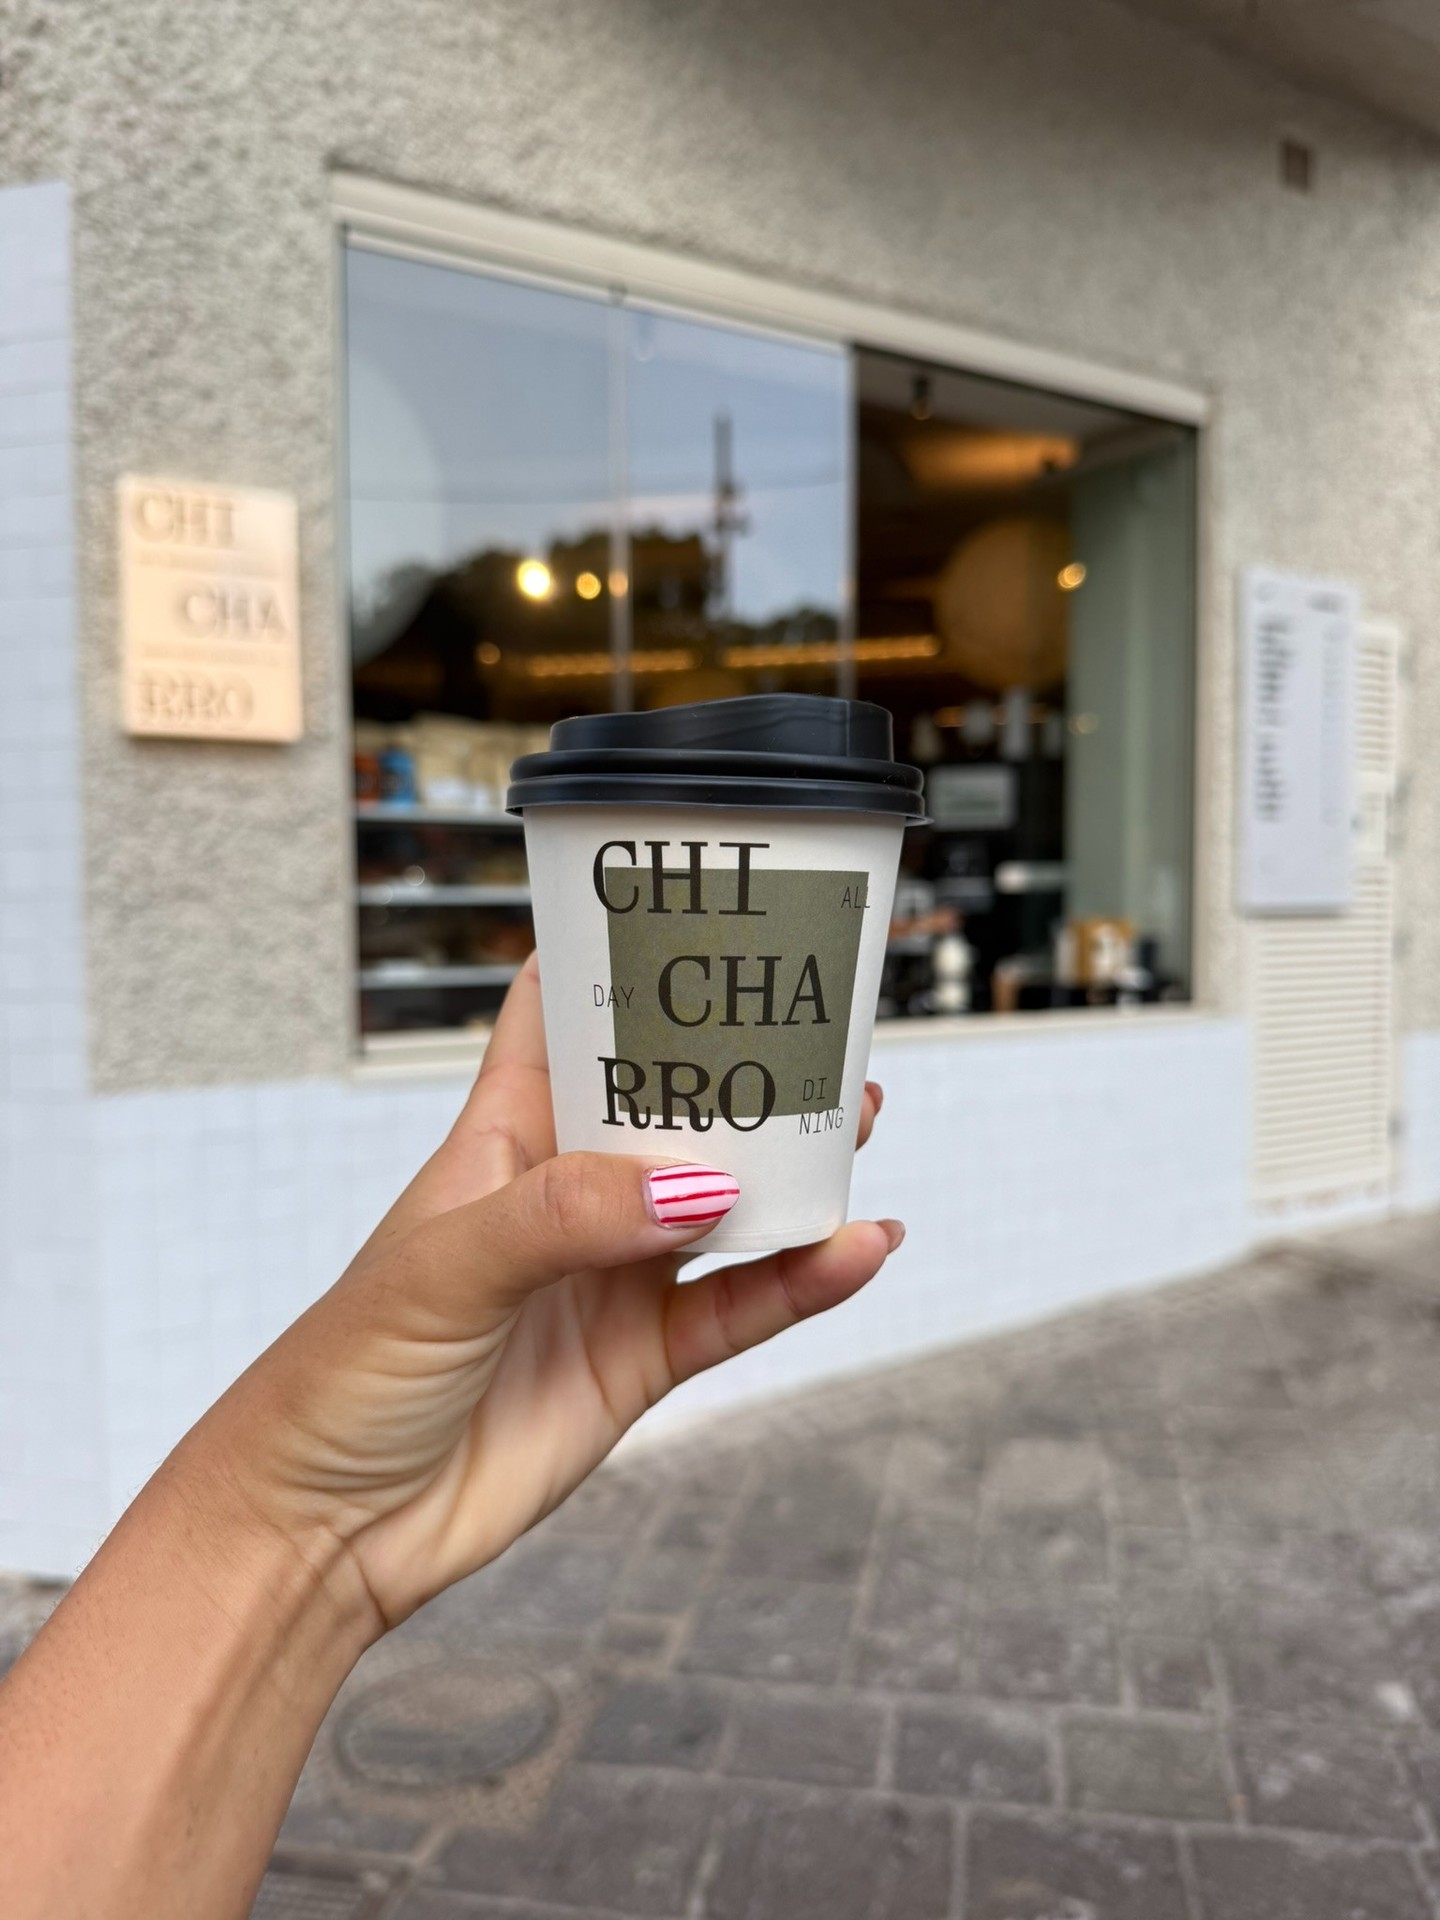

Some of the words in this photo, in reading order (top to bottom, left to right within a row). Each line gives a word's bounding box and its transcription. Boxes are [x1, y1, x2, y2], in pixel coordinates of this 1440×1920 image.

[133, 491, 237, 548] CHI
[175, 578, 289, 643] CHA
[593, 840, 770, 916] CHI
[841, 886, 871, 909] ALL
[593, 984, 635, 1009] DAY
[657, 954, 831, 1028] CHA
[597, 1056, 776, 1133] RRO
[803, 1077, 826, 1101] DI
[800, 1107, 844, 1136] NING
